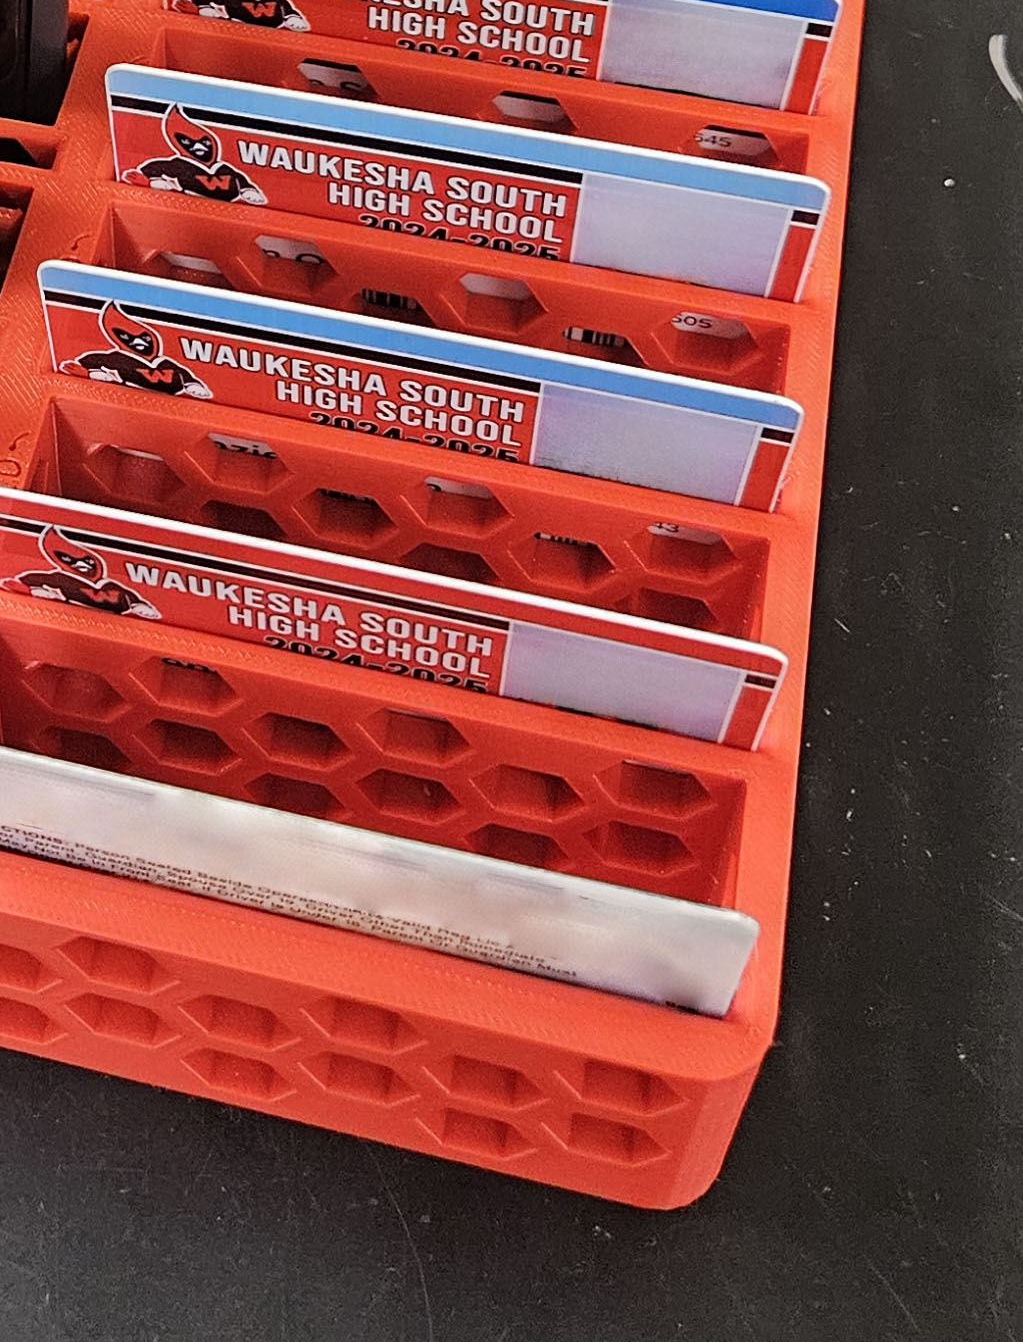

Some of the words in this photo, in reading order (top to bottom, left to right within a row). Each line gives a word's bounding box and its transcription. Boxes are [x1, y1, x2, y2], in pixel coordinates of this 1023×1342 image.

[241, 1, 277, 18] W
[367, 6, 446, 40] HIGH
[457, 21, 590, 63] SCHOOL
[195, 174, 231, 191] W
[237, 140, 436, 195] WAUKESHA
[446, 175, 567, 217] SOUTH
[328, 181, 411, 216] HIGH
[422, 198, 563, 244] SCHOOL
[136, 367, 175, 384] W
[180, 336, 387, 397] WAUKESHA
[399, 380, 525, 424] SOUTH
[276, 380, 363, 415] HIGH
[375, 400, 521, 447] SCHOOL
[124, 561, 346, 626] WAUKESHA
[359, 612, 493, 657] SOUTH
[228, 604, 320, 642] HIGH
[334, 627, 490, 678] SCHOOL
